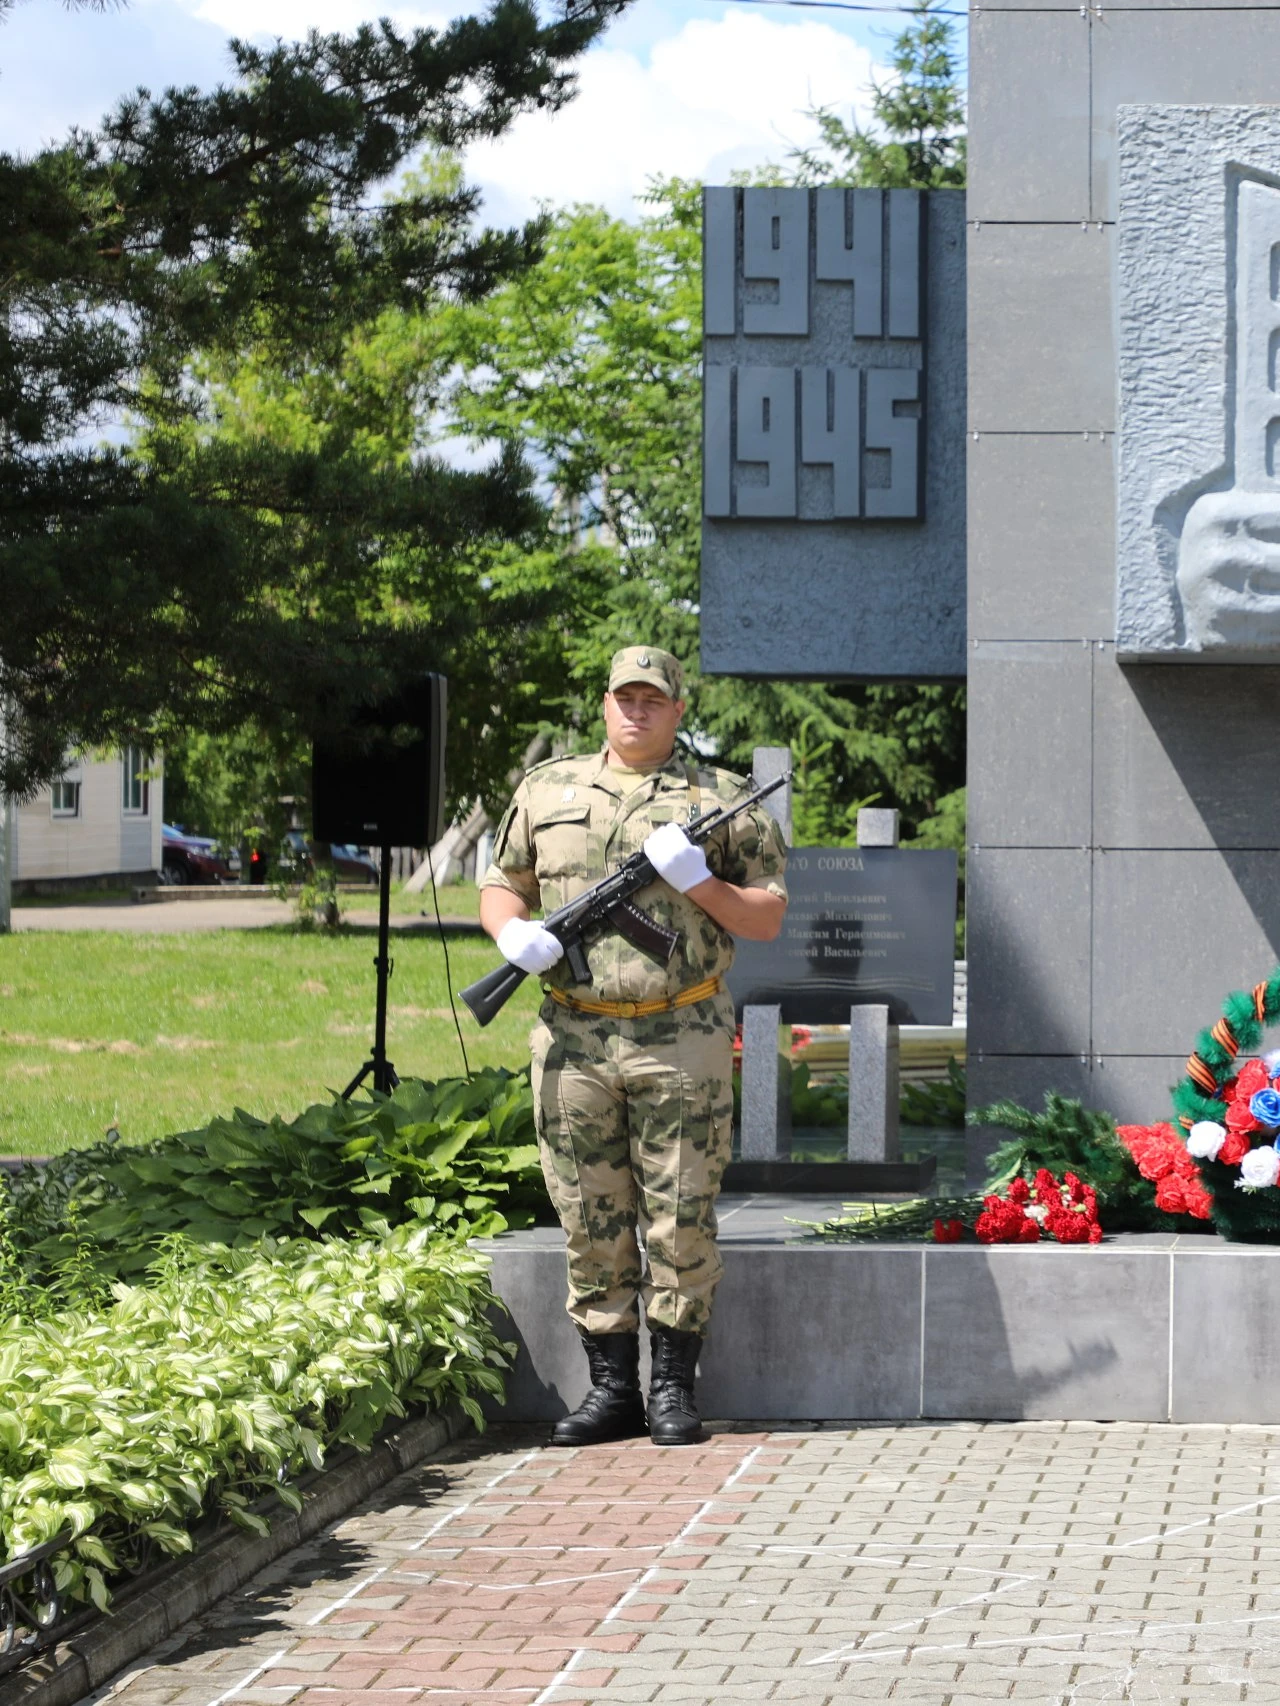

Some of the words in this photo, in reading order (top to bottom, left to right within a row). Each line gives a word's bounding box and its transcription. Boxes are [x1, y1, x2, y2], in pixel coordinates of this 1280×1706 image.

[704, 186, 920, 337] 1941
[704, 365, 920, 518] 1945
[817, 856, 865, 872] СОЮЗА
[788, 927, 830, 939] Максим
[824, 945, 888, 957] Васильевич
